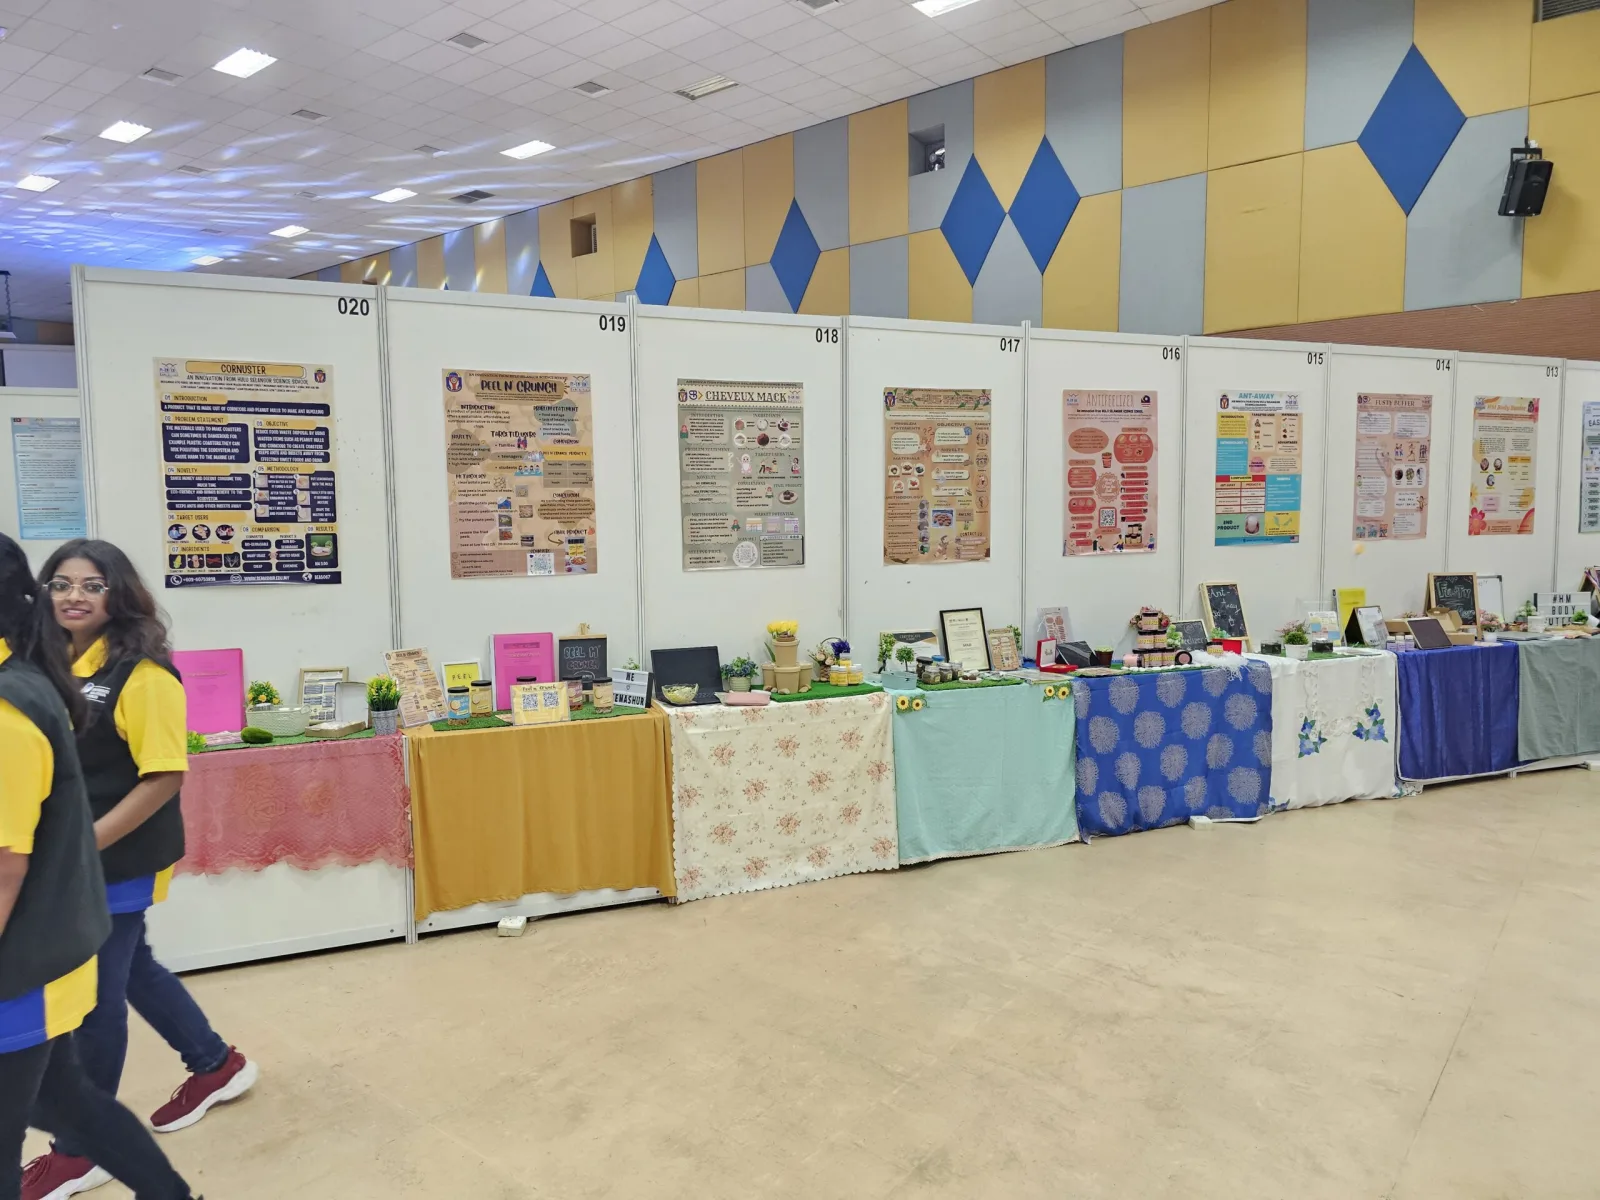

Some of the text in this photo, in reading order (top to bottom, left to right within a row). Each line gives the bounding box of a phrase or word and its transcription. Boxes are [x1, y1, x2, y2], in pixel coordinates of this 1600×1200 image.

[337, 297, 370, 316] 020
[599, 315, 626, 332] 019
[815, 328, 839, 344] 018
[1000, 337, 1020, 353] 017
[1162, 347, 1180, 360] 016
[1307, 352, 1323, 365] 015
[221, 364, 266, 375] CORNUSTER
[1436, 359, 1450, 371] 014
[1546, 366, 1559, 377] 013
[481, 380, 502, 391] PEEL
[516, 380, 557, 394] CRUNCH
[705, 390, 787, 402] CHEVEUX MACK
[1552, 605, 1576, 615] BODY
[613, 693, 645, 706] EMASHUR
